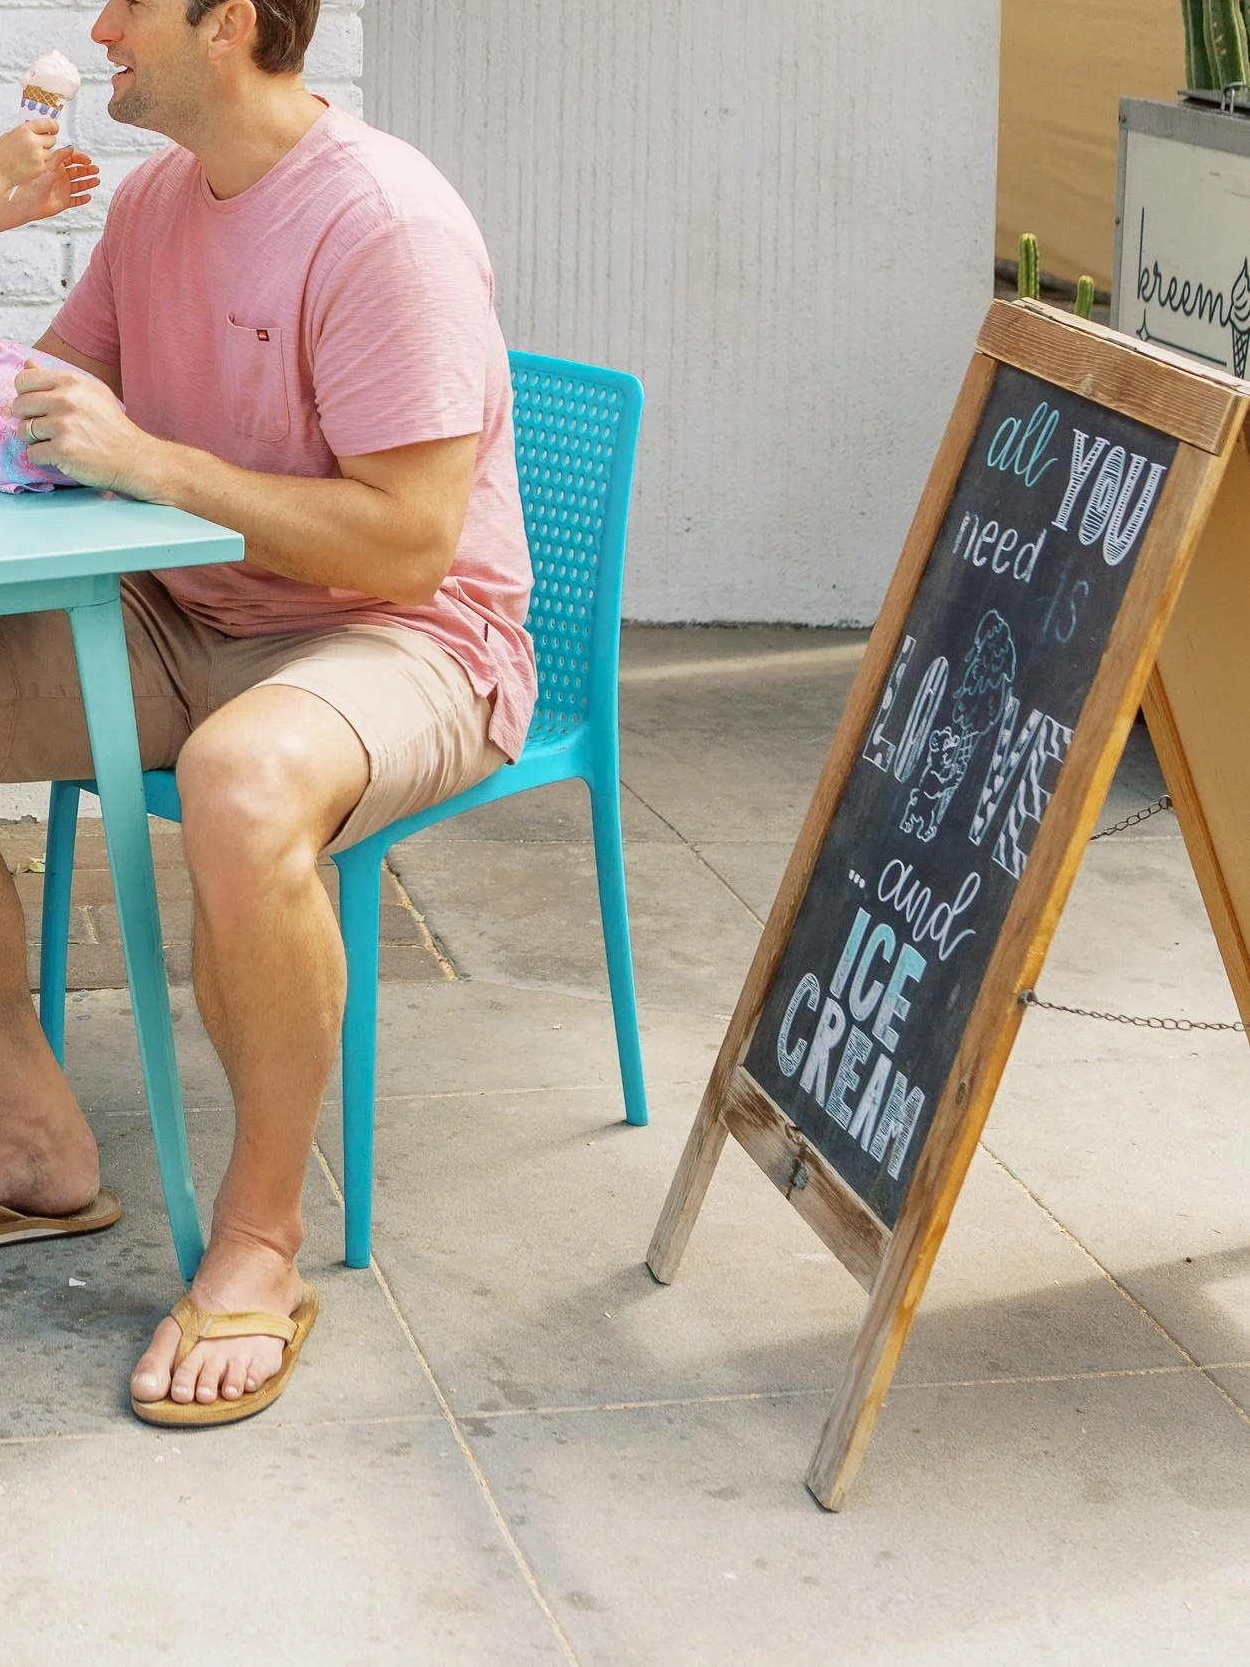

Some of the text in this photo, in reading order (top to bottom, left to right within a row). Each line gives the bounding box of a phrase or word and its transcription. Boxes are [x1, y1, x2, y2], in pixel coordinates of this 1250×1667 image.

[953, 511, 1047, 582] need
[987, 401, 1167, 565] all YOU
[829, 907, 927, 1051] ICE
[776, 972, 926, 1182] CREAM
